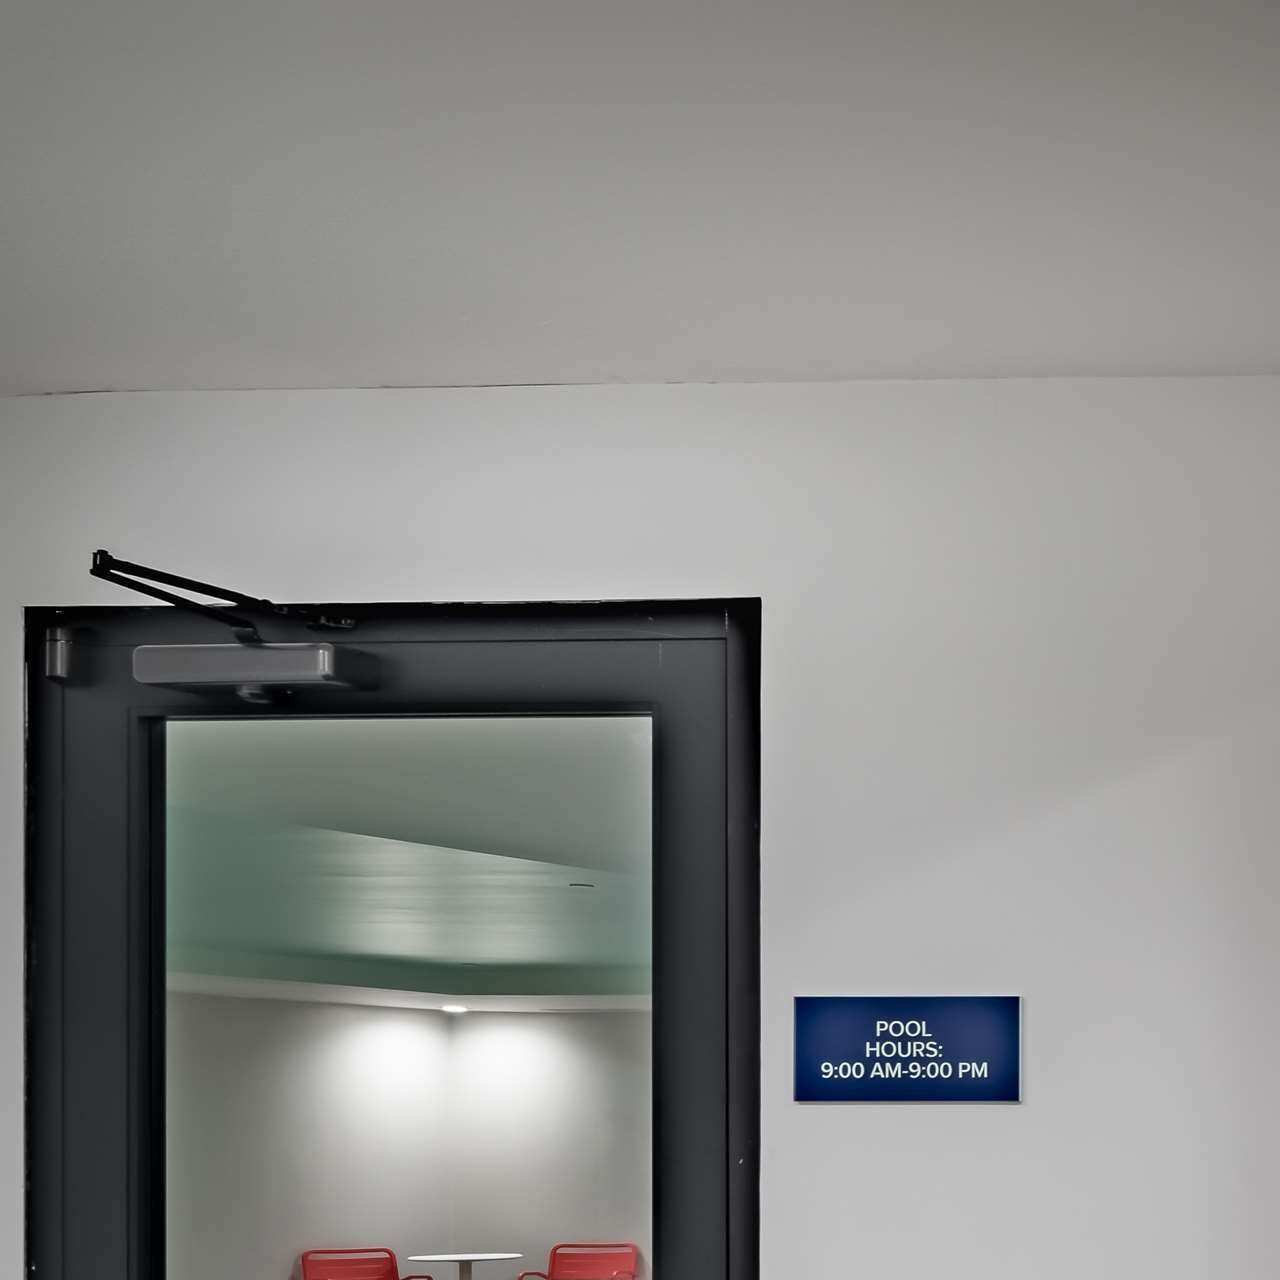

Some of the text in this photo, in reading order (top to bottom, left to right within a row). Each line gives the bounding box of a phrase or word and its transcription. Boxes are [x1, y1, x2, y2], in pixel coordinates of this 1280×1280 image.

[875, 1020, 933, 1037] POOL
[865, 1041, 944, 1058] HOURS:
[820, 1061, 989, 1079] 9:00 AM-9:00 PM
